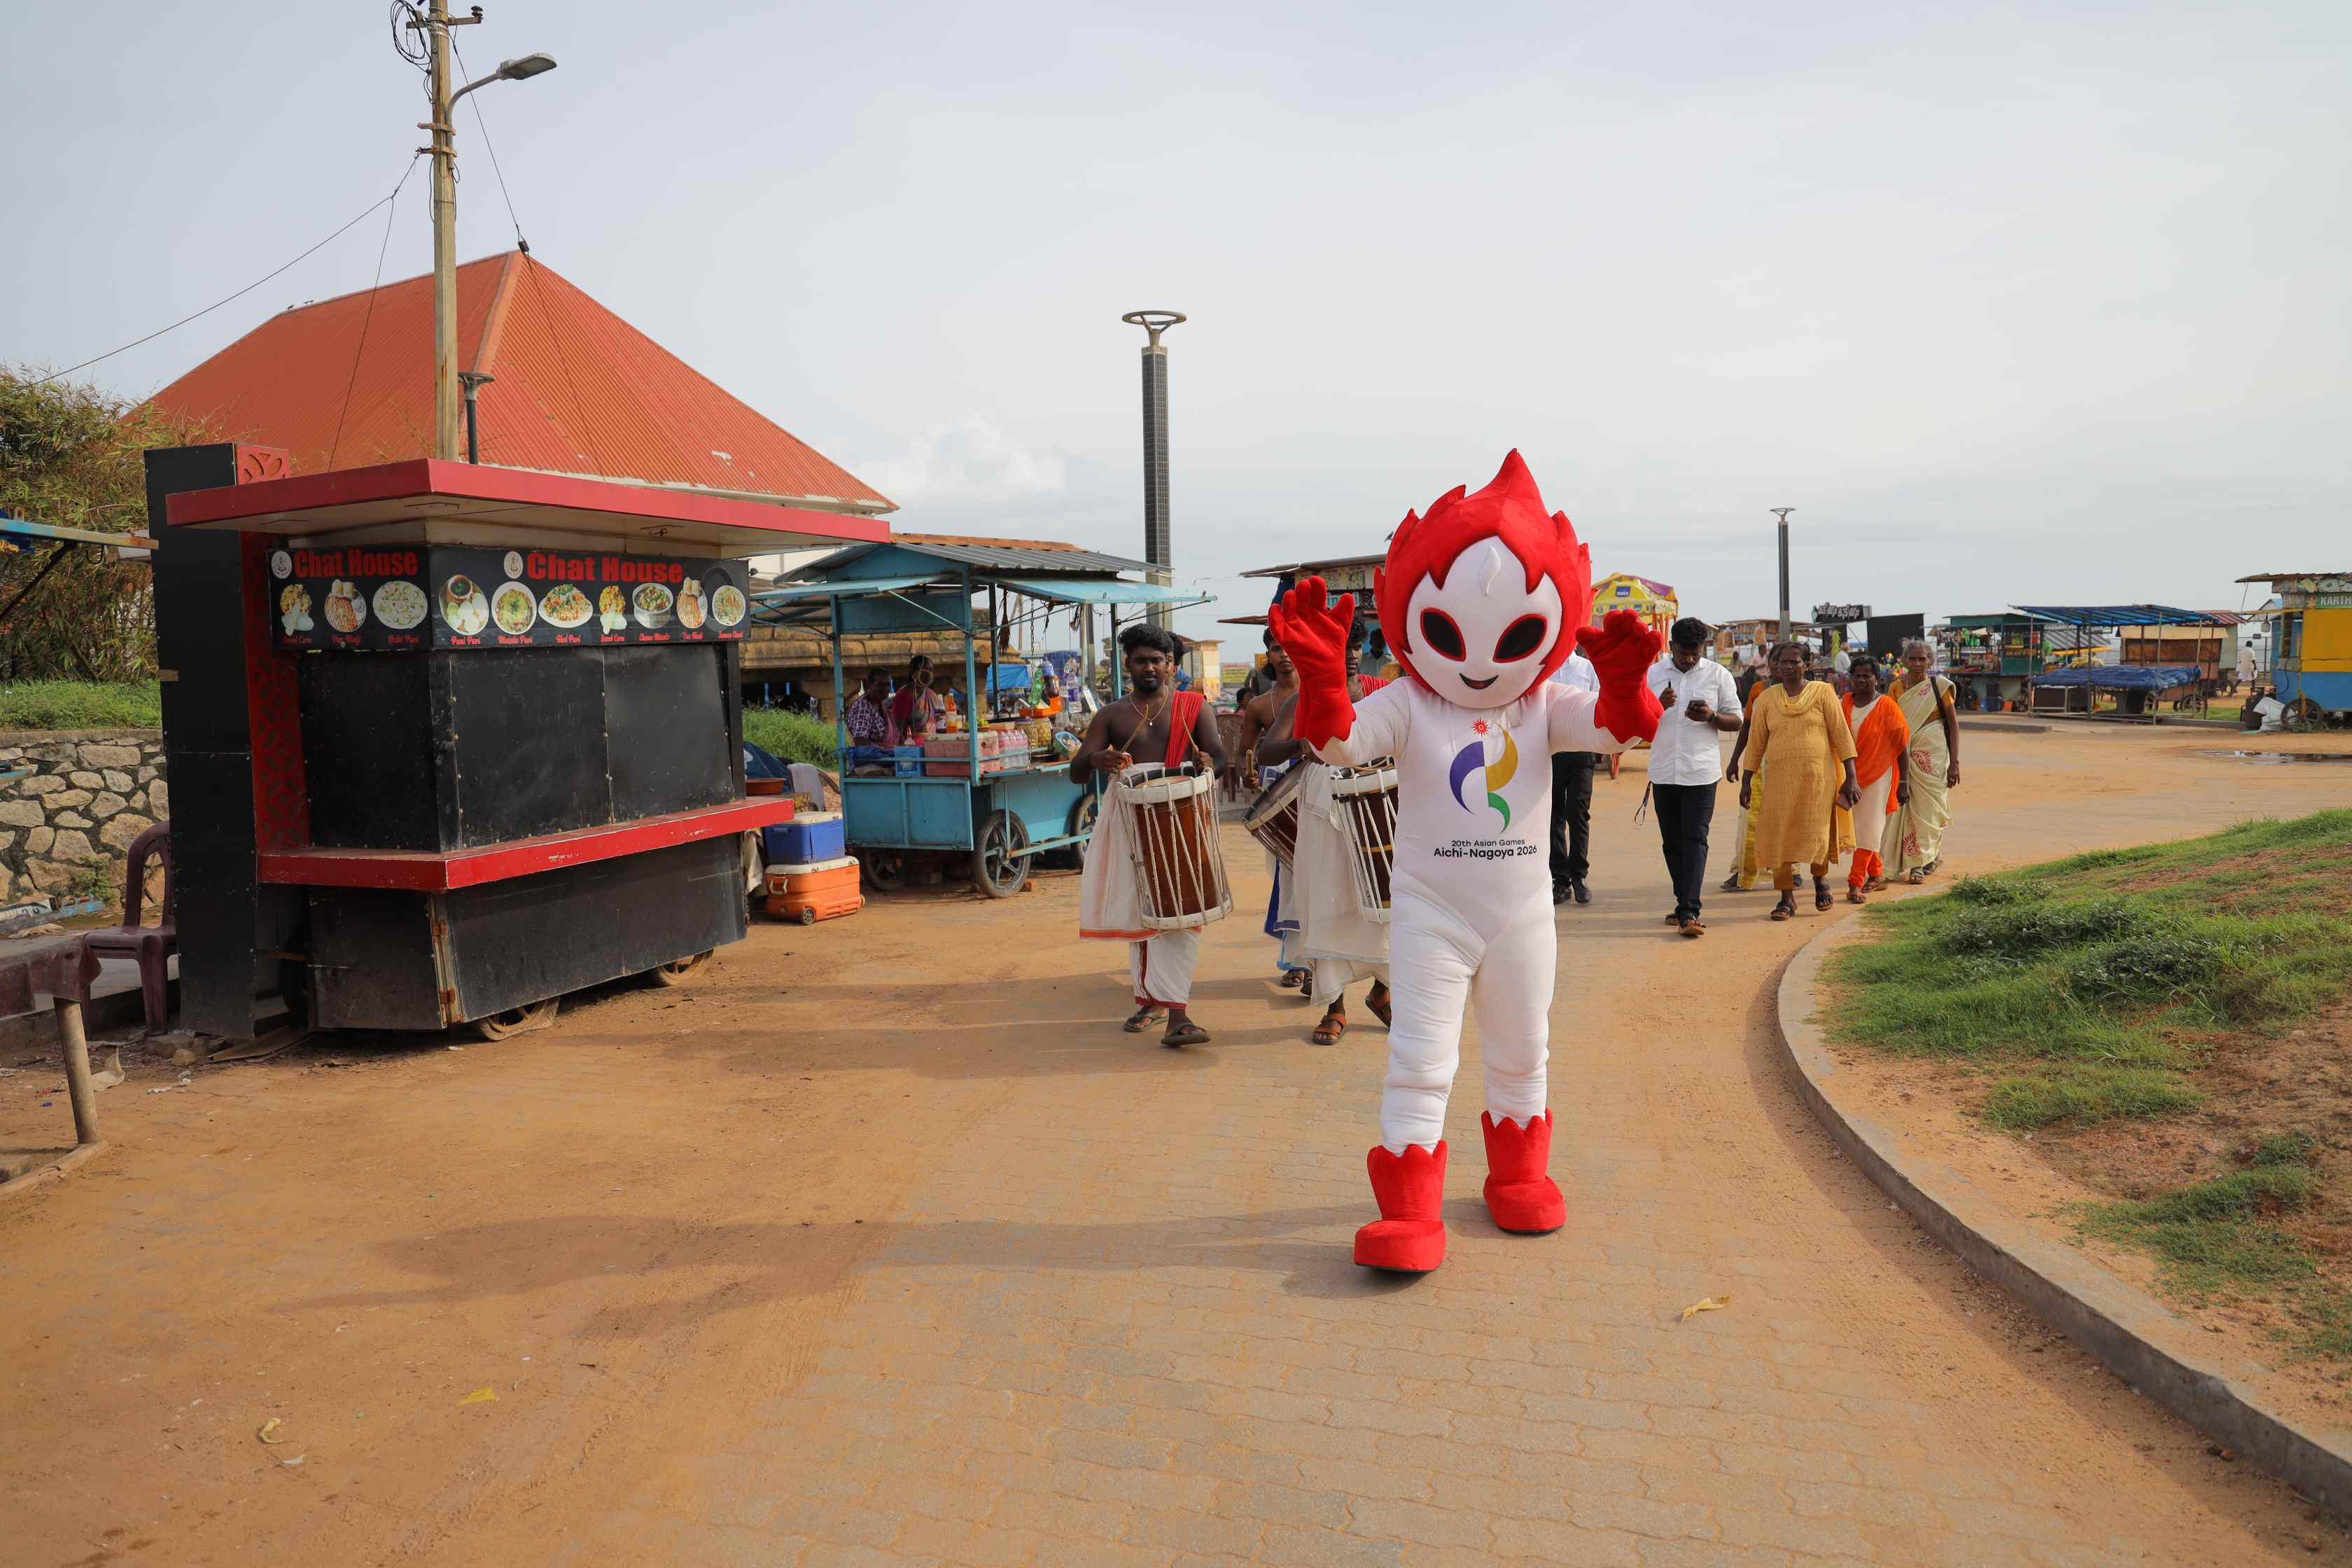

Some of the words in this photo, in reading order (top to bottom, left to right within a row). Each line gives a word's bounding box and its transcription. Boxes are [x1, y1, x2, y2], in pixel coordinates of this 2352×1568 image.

[294, 550, 344, 578] Chat
[348, 549, 419, 577] House
[527, 551, 596, 580] Chat
[601, 556, 684, 583] House
[1433, 847, 1514, 860] Aichi-Nagoya
[1516, 845, 1537, 856] 2026
